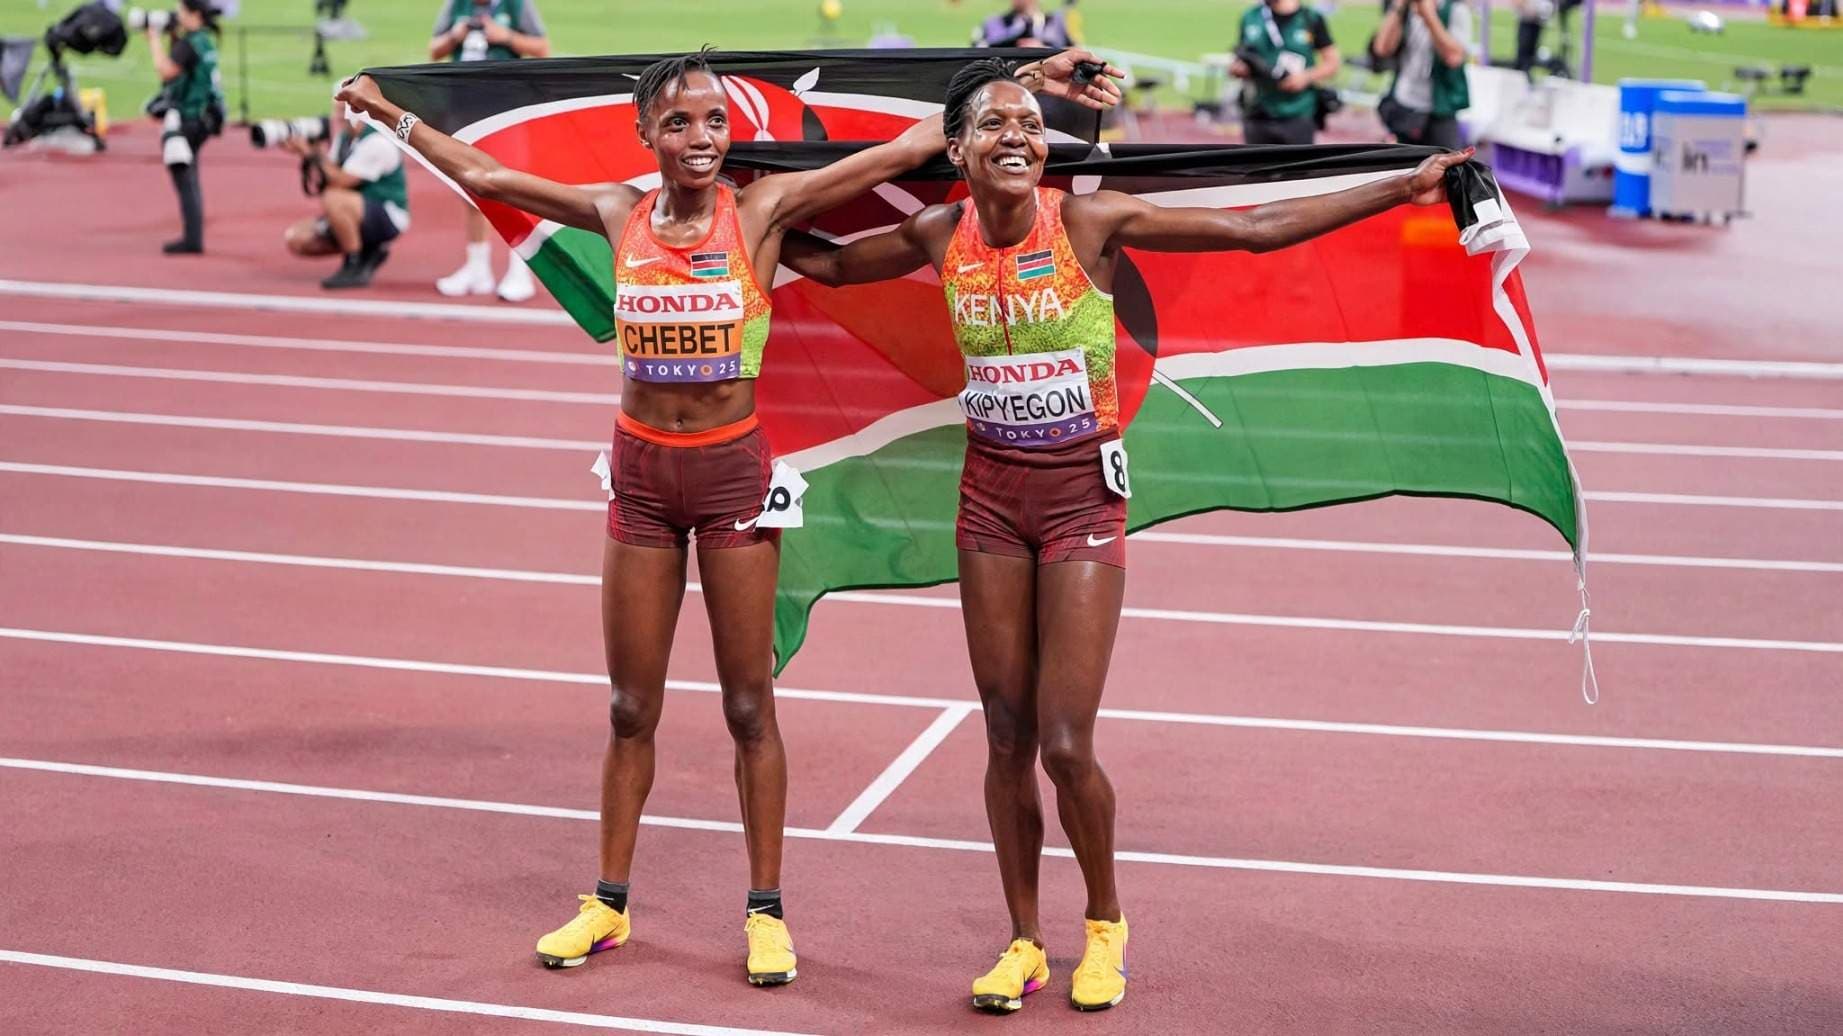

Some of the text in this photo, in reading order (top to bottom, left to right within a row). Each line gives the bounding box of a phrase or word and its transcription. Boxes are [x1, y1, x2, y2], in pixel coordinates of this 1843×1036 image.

[617, 293, 740, 313] HONDA
[954, 287, 1066, 327] KENYA
[624, 323, 735, 354] CHEBET
[646, 360, 736, 376] TOKYO 25
[969, 358, 1083, 384] HONDA
[964, 385, 1086, 421] KIPYEGON
[1069, 418, 1091, 434] 25
[1110, 450, 1126, 492] 8
